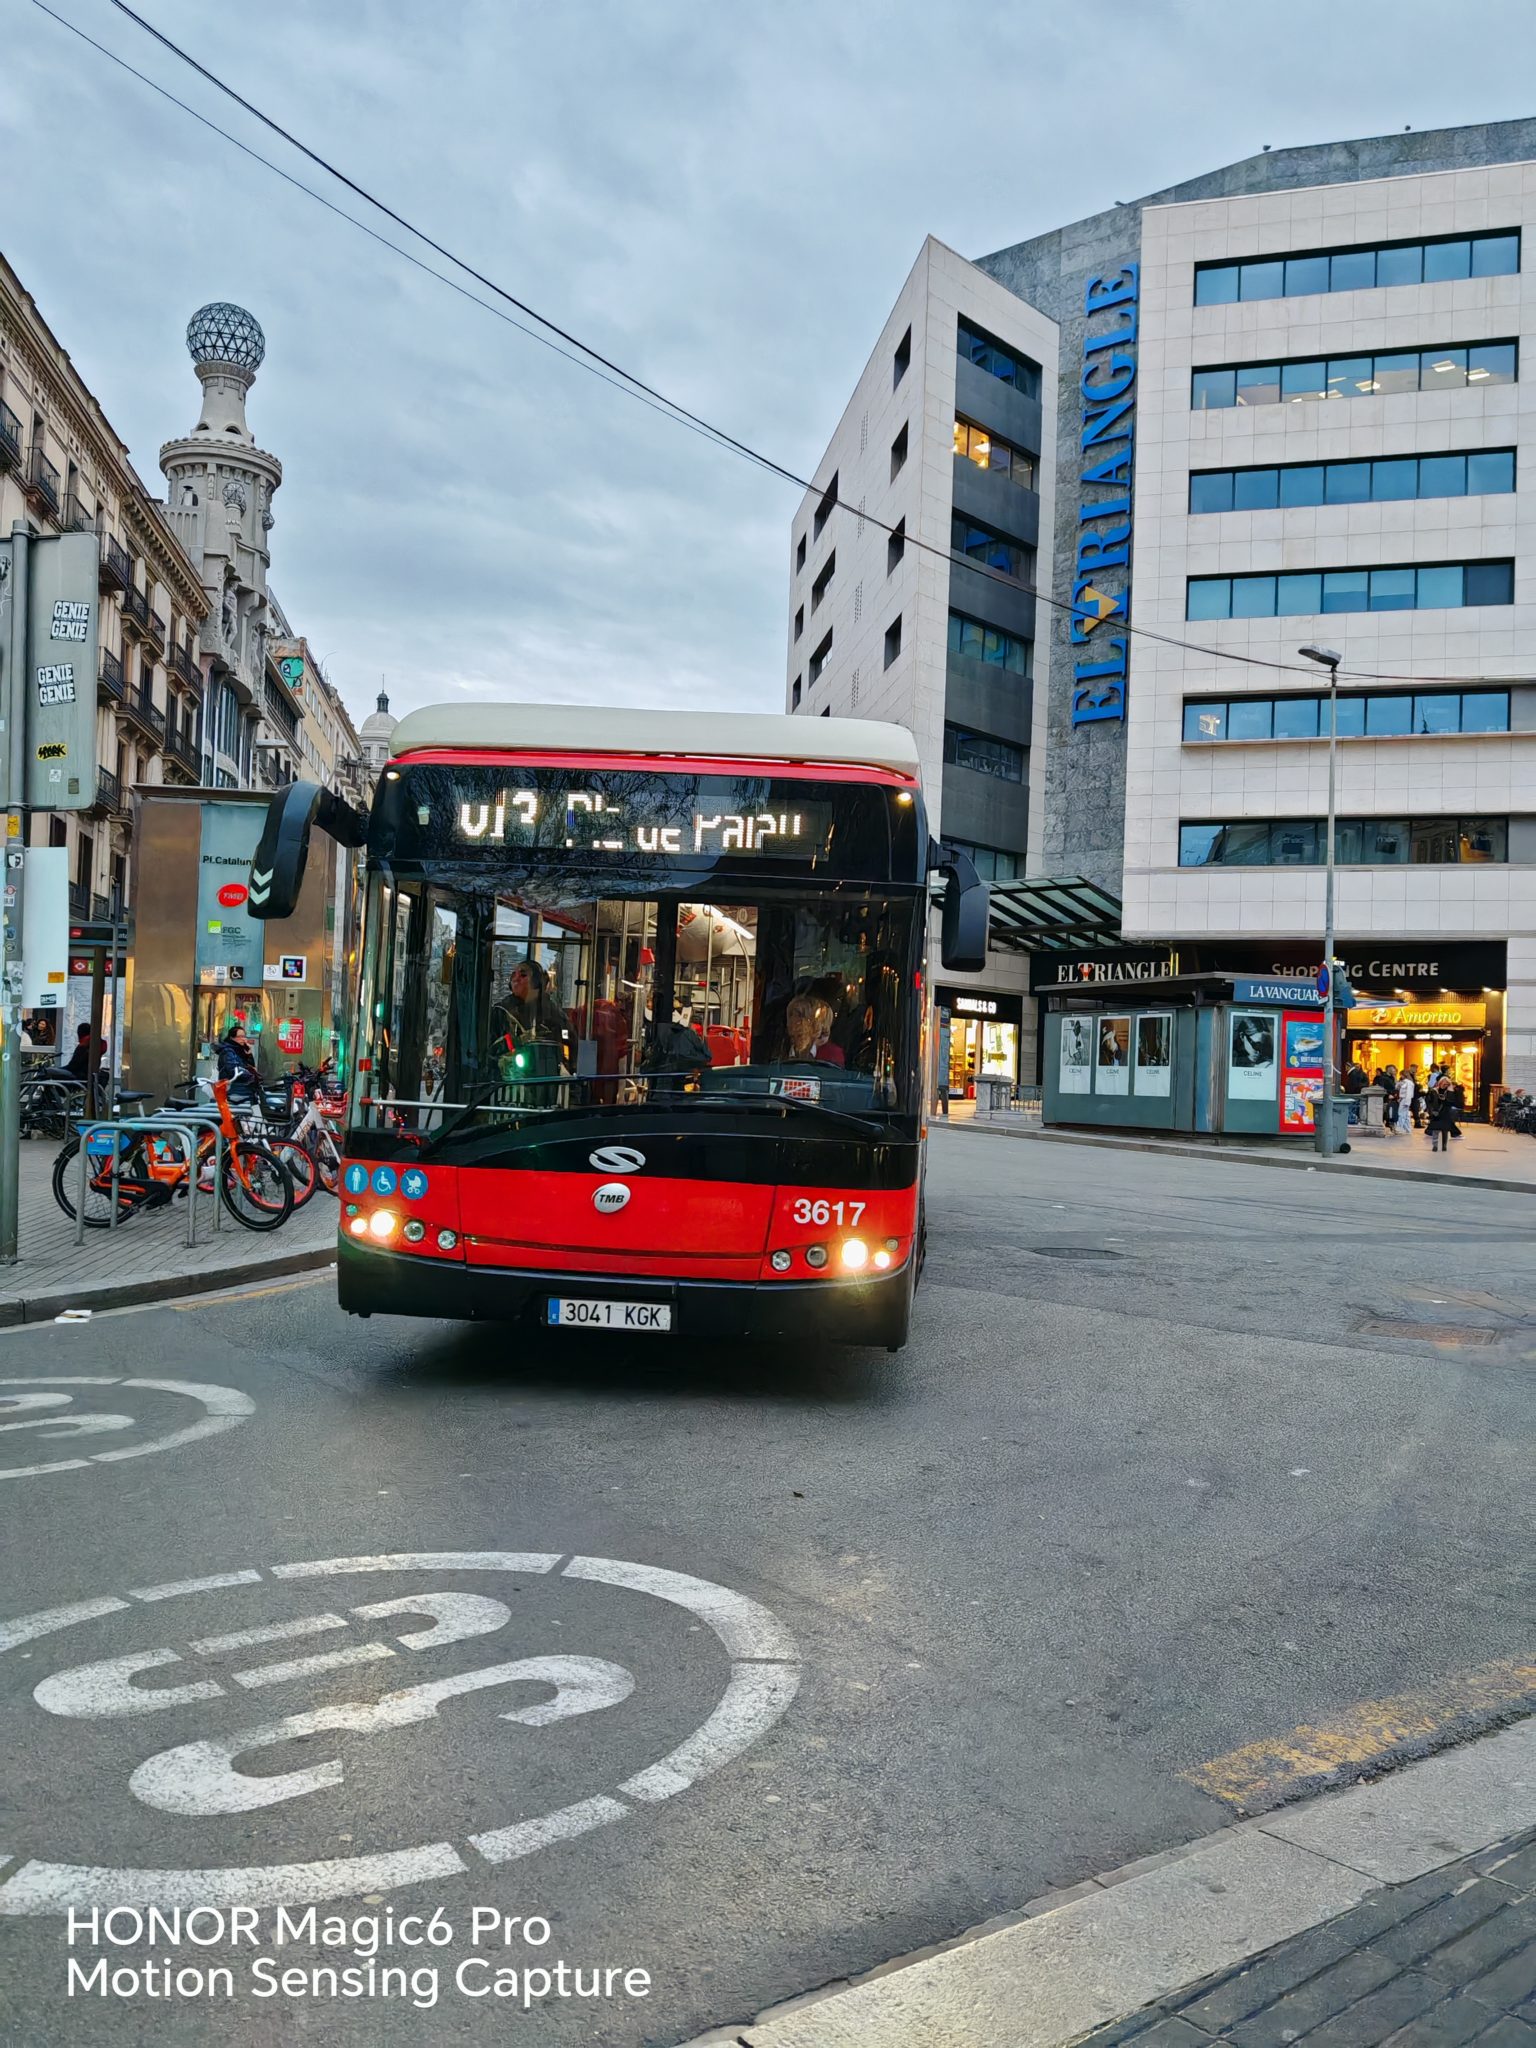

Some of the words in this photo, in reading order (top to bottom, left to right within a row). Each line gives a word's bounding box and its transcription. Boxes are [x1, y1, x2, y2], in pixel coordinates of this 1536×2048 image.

[1072, 263, 1139, 645] TRIANGLE
[54, 601, 90, 619] GENIE
[51, 621, 87, 638] GENIE
[37, 664, 73, 684] GENIE
[1072, 637, 1128, 728] EL
[39, 683, 76, 703] GENIE
[1057, 965, 1079, 983] EL
[1078, 961, 1172, 983] TRIANGLE
[1271, 963, 1363, 978] SHOPG
[1368, 960, 1439, 977] CENTRE
[1391, 1007, 1462, 1024] Amorino
[599, 1194, 624, 1205] TMB
[793, 1199, 866, 1226] 3617
[565, 1302, 611, 1324] 3041
[624, 1306, 661, 1328] KGK
